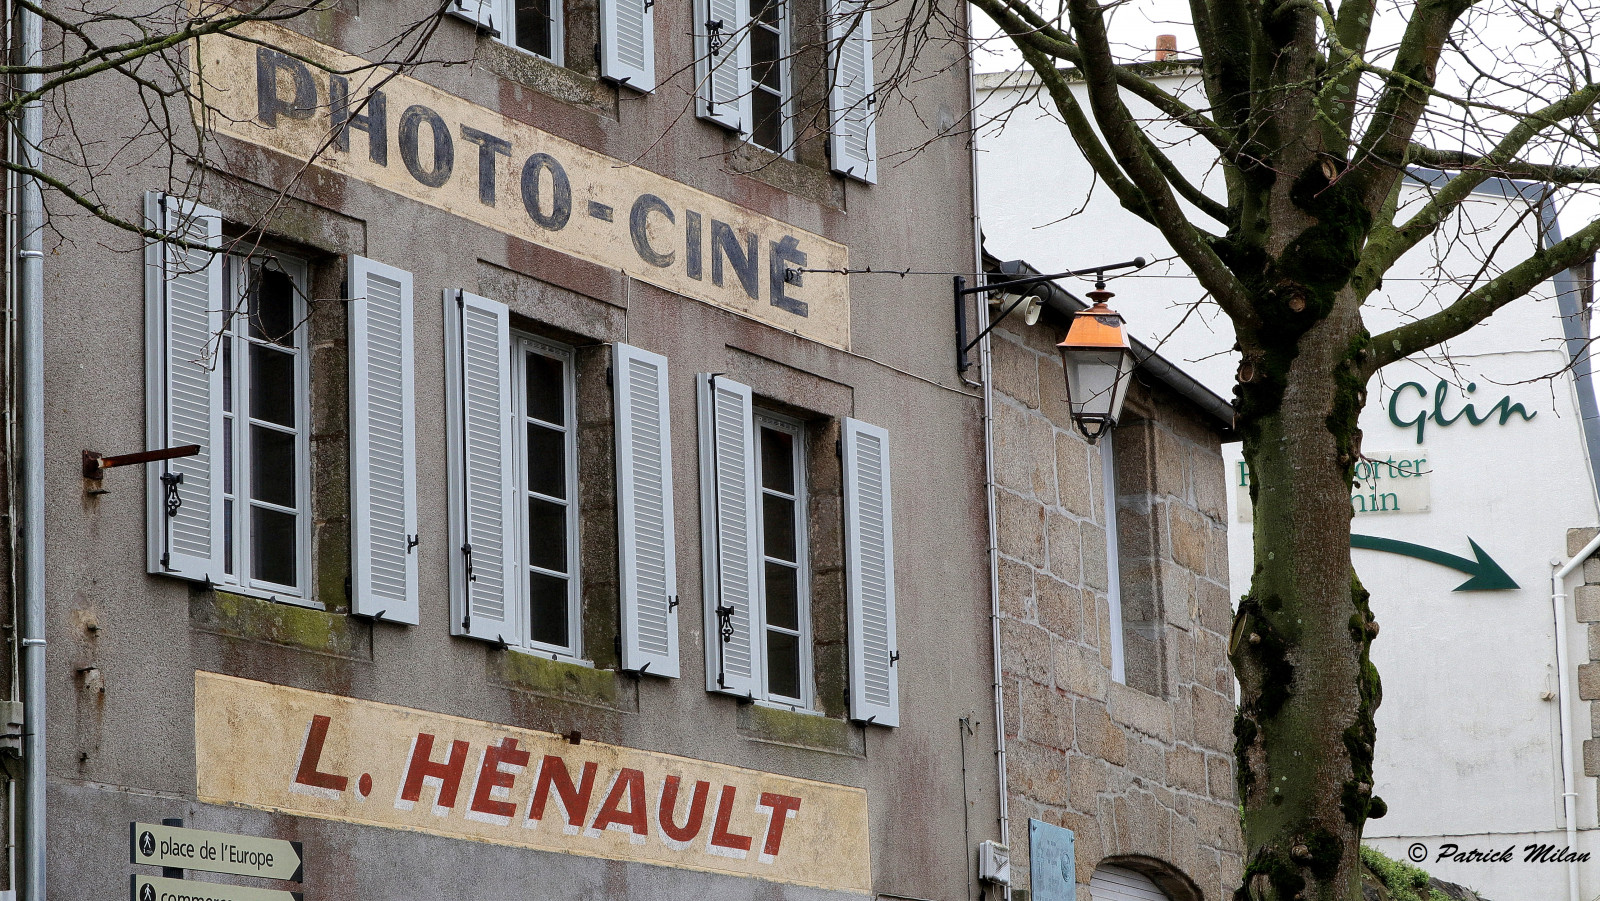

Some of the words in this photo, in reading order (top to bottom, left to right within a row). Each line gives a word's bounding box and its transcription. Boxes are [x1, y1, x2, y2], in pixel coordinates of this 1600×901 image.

[1389, 379, 1537, 444] Glin
[1354, 455, 1427, 480] orter
[290, 714, 373, 801] L.
[394, 733, 801, 865] HÉNAULT
[160, 836, 195, 859] place
[200, 840, 216, 861] de
[221, 842, 274, 871] l'Europe
